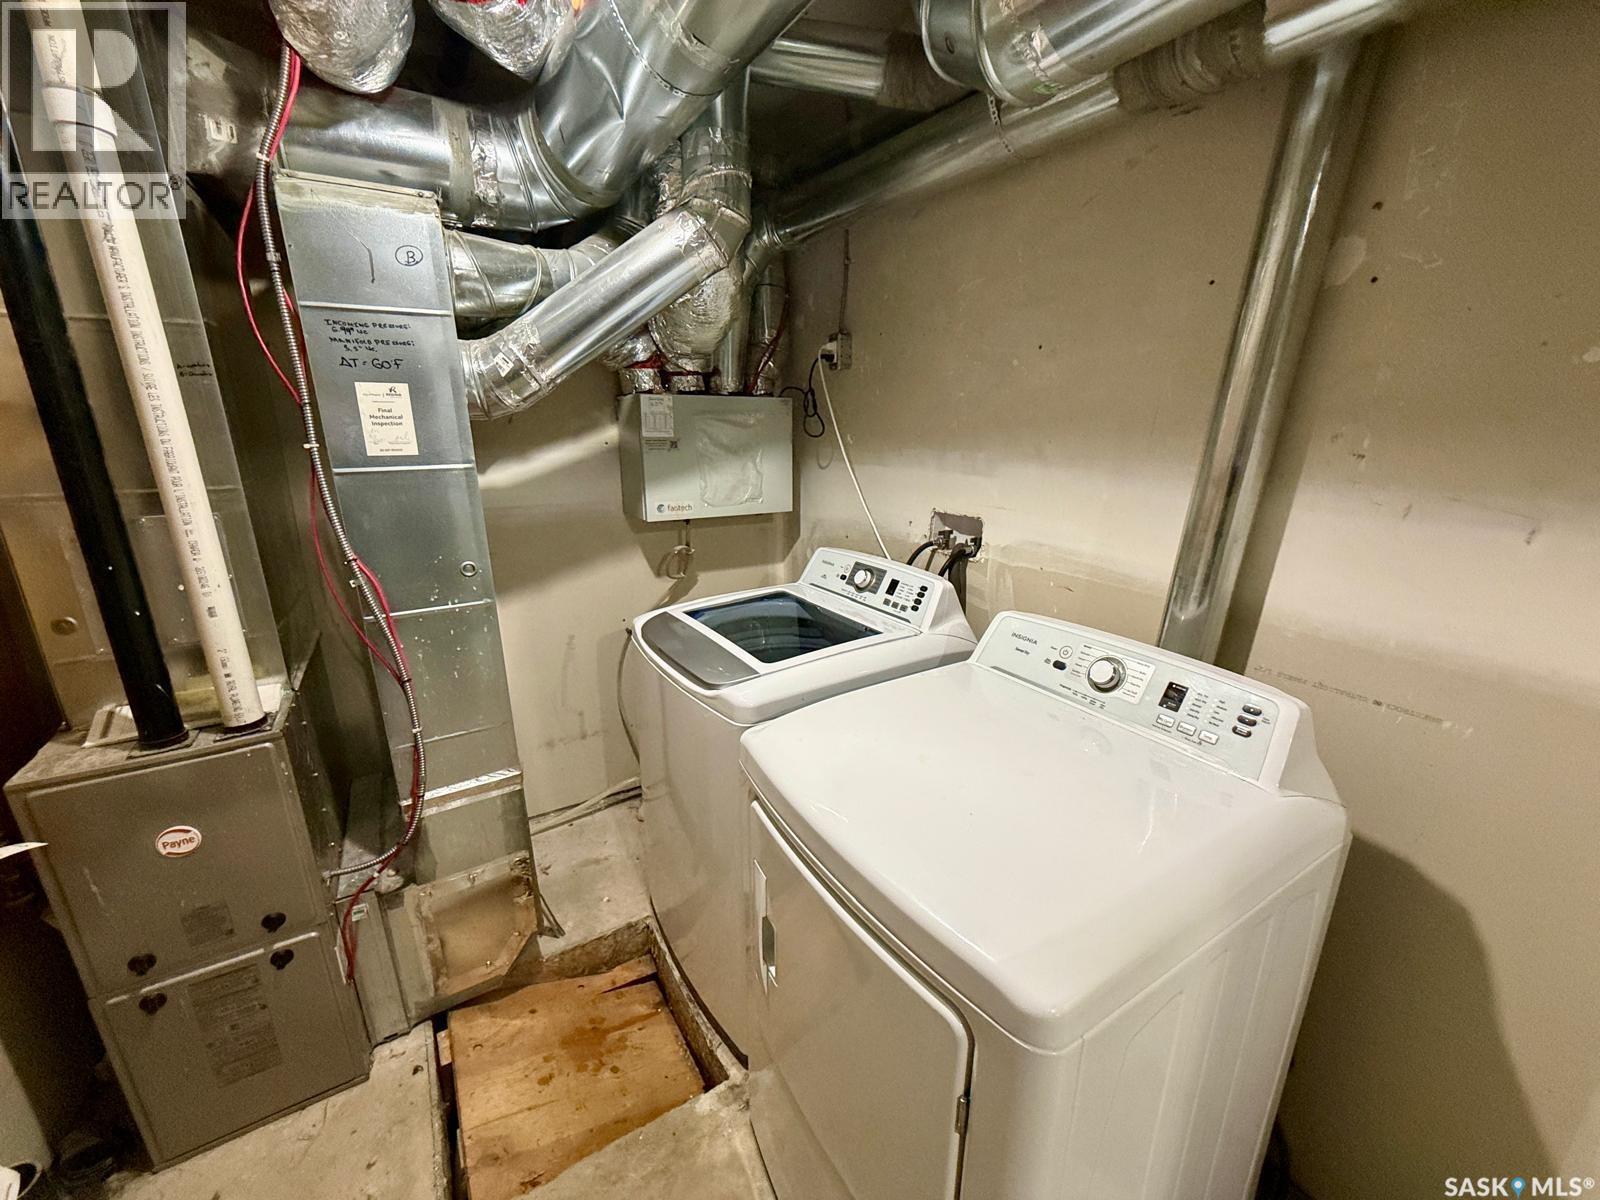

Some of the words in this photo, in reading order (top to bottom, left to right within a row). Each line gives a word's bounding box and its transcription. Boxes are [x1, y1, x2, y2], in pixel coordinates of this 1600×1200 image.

[405, 250, 419, 265] B
[324, 319, 369, 328] INCOMING
[329, 337, 372, 345] MANIFOLD
[1011, 632, 1038, 646] INSIGNIA
[162, 836, 195, 850] Payne
